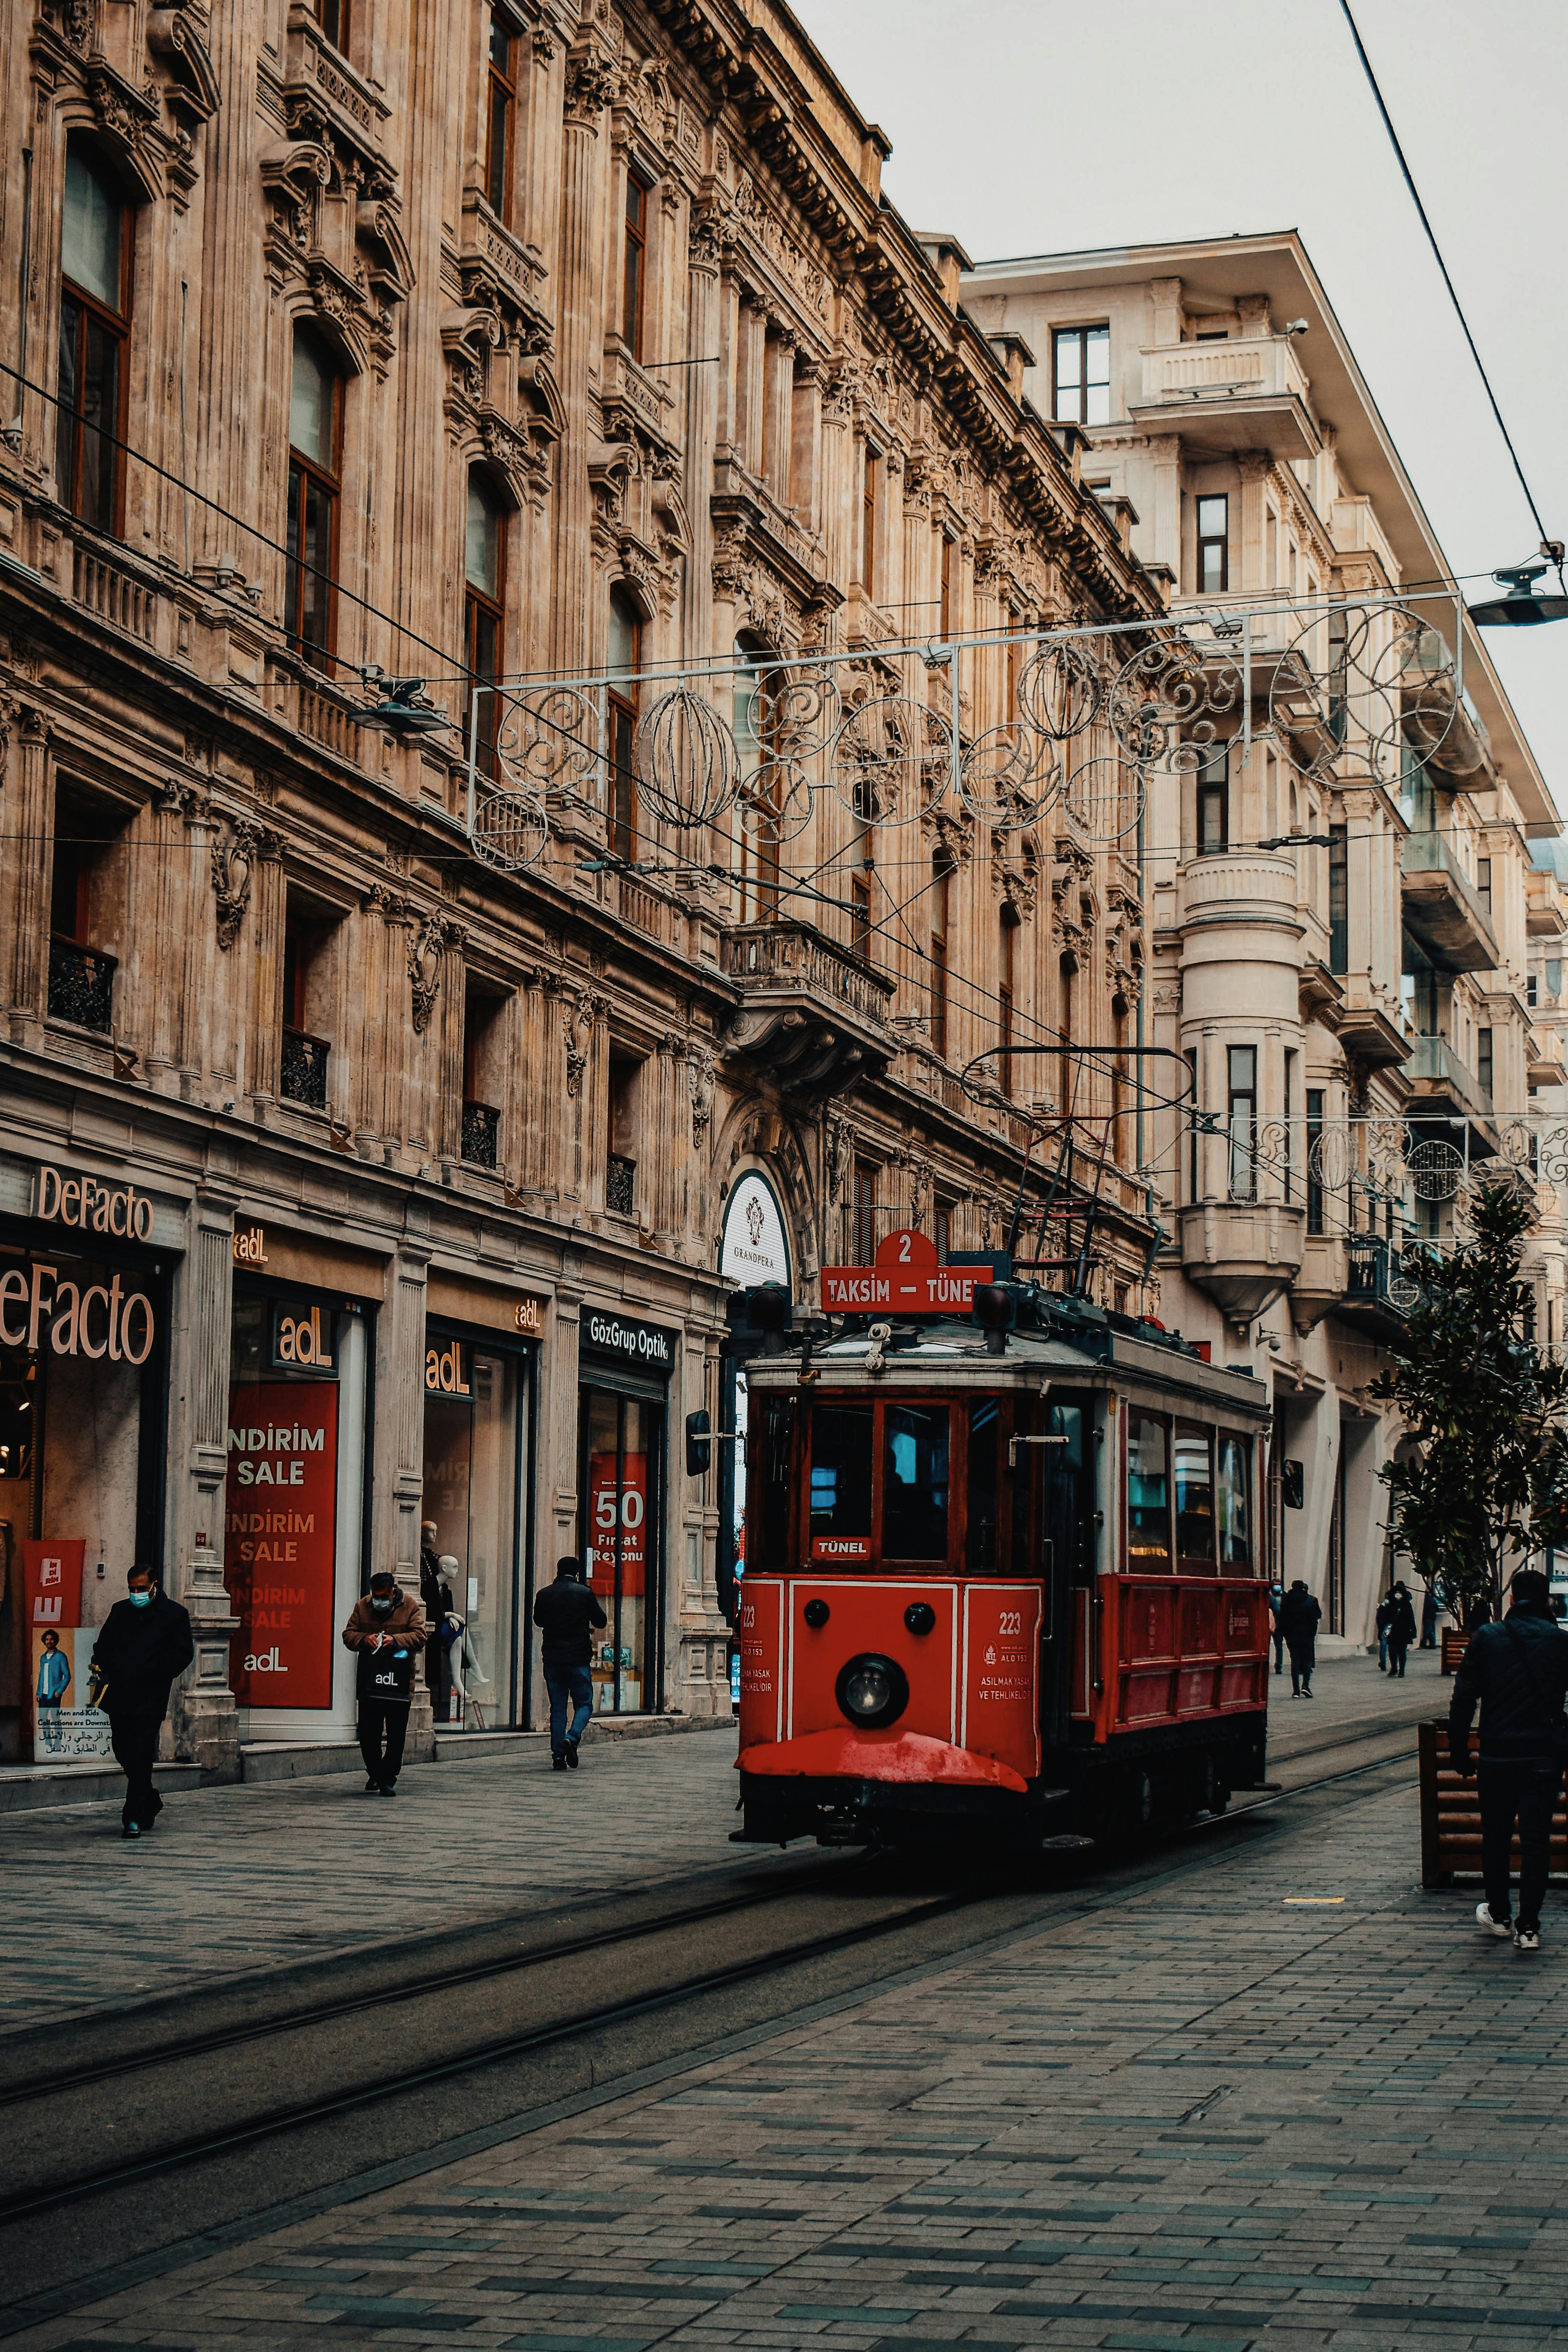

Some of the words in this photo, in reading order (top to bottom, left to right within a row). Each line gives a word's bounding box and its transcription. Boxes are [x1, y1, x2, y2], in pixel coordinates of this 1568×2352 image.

[38, 1167, 154, 1241] DeFacto
[734, 1247, 774, 1269] GRANDPERA
[900, 1235, 911, 1262] 2
[828, 1274, 889, 1302] TAKSİM
[927, 1273, 977, 1302] TÜNE
[0, 1263, 154, 1364] eFacto
[591, 1317, 635, 1355] GözGrup
[638, 1330, 666, 1359] Optik
[228, 1422, 324, 1451] NDİRİM
[238, 1461, 304, 1484] SALE
[225, 1508, 314, 1533] İNDİRİM
[598, 1534, 637, 1545] Fırat
[819, 1541, 866, 1553] TÜNEL
[241, 1542, 297, 1561] SALE
[244, 1611, 291, 1628] SALE
[999, 1612, 1020, 1634] 223
[753, 1670, 770, 1678] YASAK
[981, 1677, 1012, 1686] ASILMAK
[979, 1691, 988, 1699] VE
[990, 1689, 1030, 1699] TEHLİKELİDR
